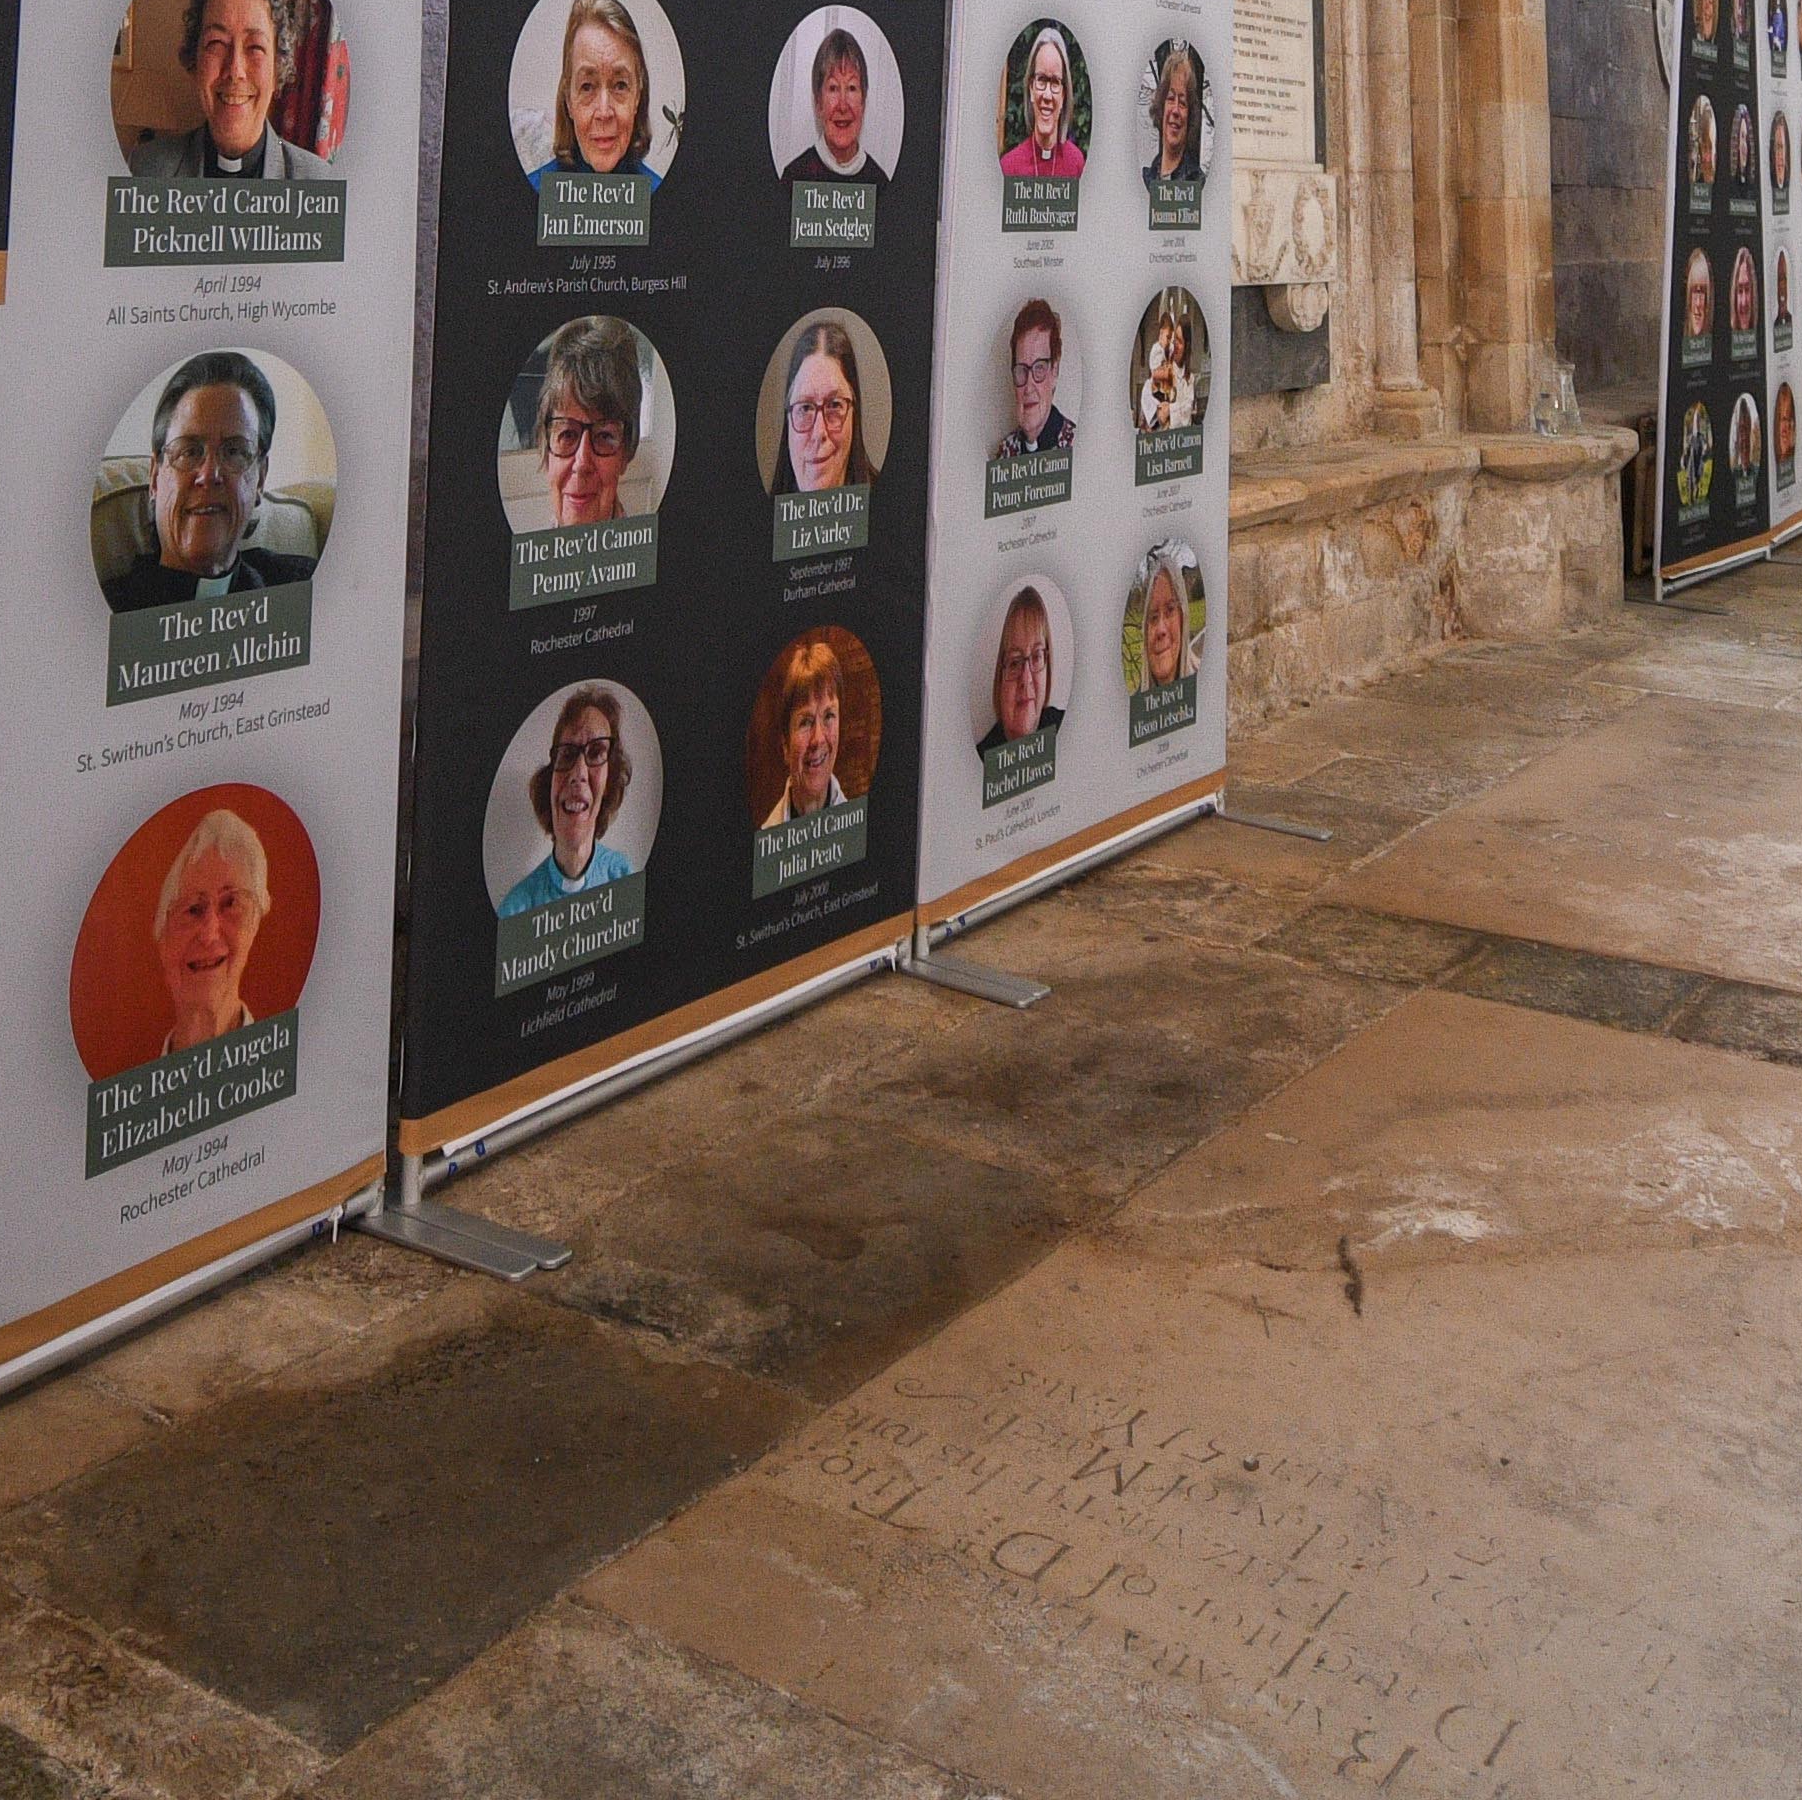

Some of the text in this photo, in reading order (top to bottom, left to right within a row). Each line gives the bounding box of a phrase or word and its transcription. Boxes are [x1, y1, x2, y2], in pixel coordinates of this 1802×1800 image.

[115, 187, 339, 219] The Rev'd Carol Jean
[556, 180, 634, 204] The Rev'd
[1014, 182, 1032, 200] The
[1047, 183, 1070, 200] Rev'd
[542, 214, 644, 239] Jan Emerson
[1006, 207, 1028, 224] Ruth
[133, 226, 223, 254] Picknell
[516, 527, 653, 564] The Rev'd Canon
[532, 562, 636, 595] Penny Avann
[159, 597, 268, 642] The Rev'd
[117, 632, 301, 692] Maureen Allchin
[97, 1023, 290, 1117] The Rev'd Angela
[100, 1067, 285, 1160] Elizabeth Cooke
